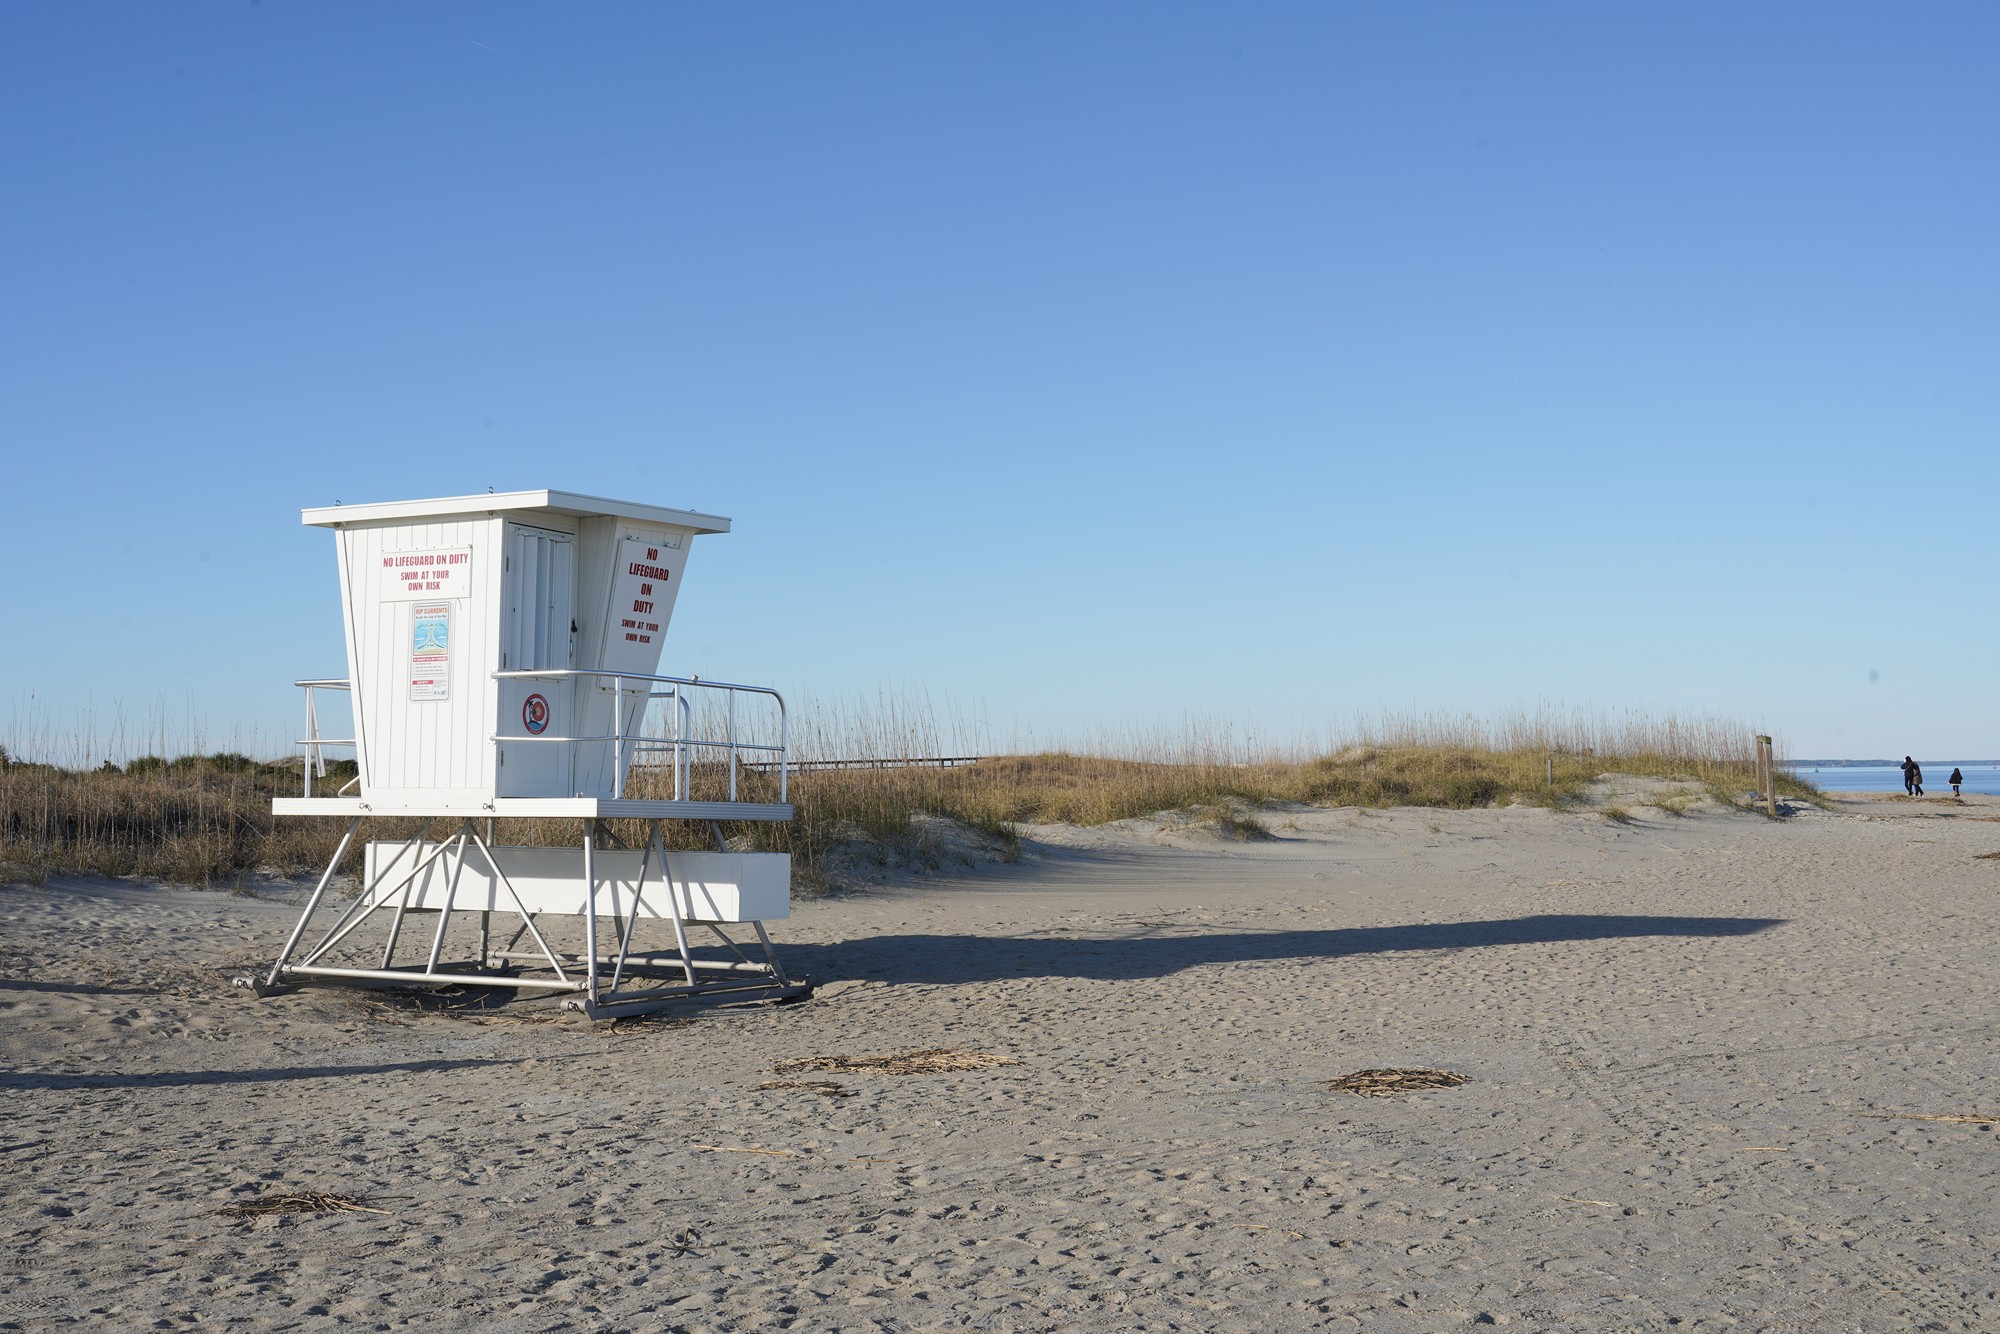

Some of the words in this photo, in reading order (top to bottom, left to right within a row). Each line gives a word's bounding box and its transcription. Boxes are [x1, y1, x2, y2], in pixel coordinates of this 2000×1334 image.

[383, 557, 393, 567] NO
[395, 555, 434, 567] LIFEGUARD
[436, 554, 447, 565] ON
[449, 553, 469, 564] DUTY
[646, 547, 658, 561] NO
[401, 571, 418, 580] SWIM
[421, 571, 429, 580] AT
[432, 570, 449, 579] YOUR
[628, 562, 669, 581] LIFEGUARD
[408, 582, 423, 591] OWN
[426, 581, 440, 590] RISK
[641, 583, 652, 596] ON
[633, 599, 654, 614] DUTY
[622, 619, 636, 629] SWIM
[637, 621, 644, 630] AT
[646, 623, 659, 632] YOUR
[626, 632, 638, 642] OWN
[639, 634, 650, 644] RISK
